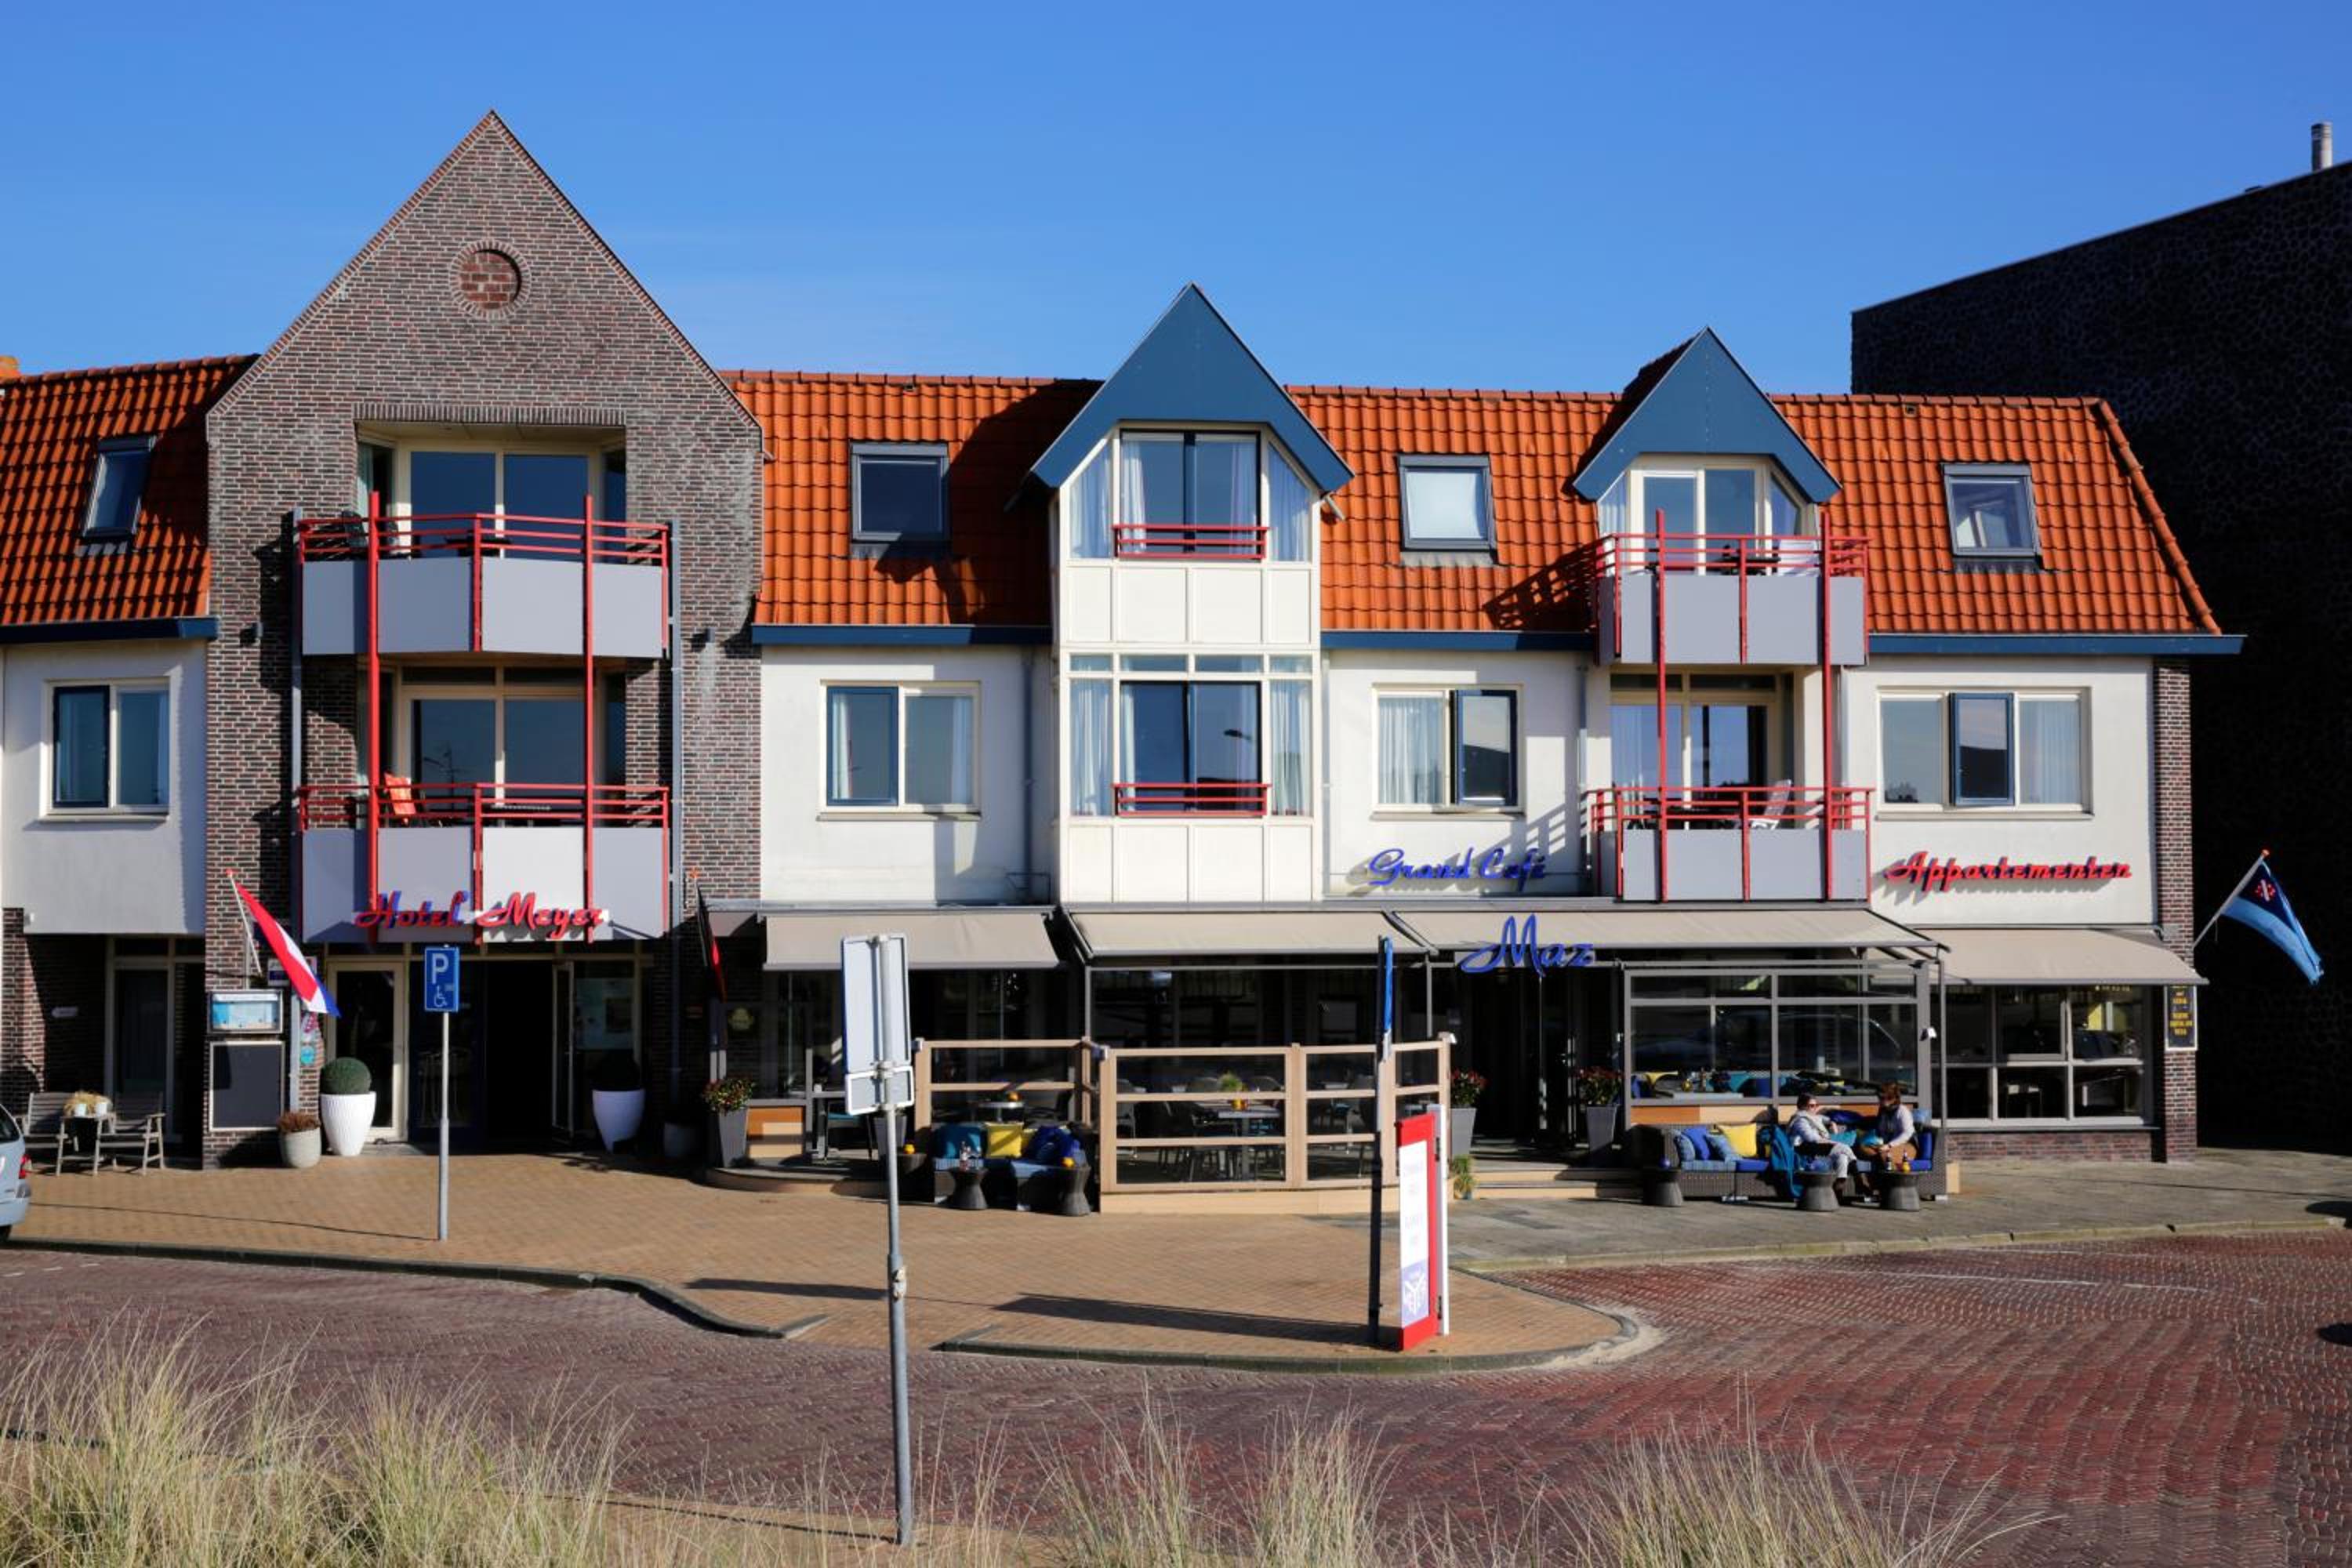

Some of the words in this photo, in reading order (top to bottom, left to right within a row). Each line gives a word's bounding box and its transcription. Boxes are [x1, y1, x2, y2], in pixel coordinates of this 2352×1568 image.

[1369, 847, 1473, 886] Grand
[1886, 851, 2132, 891] Appartementen
[354, 890, 470, 929] Hotel
[475, 891, 604, 940] Meyer
[1460, 913, 1594, 978] Maz
[431, 953, 449, 985] P
